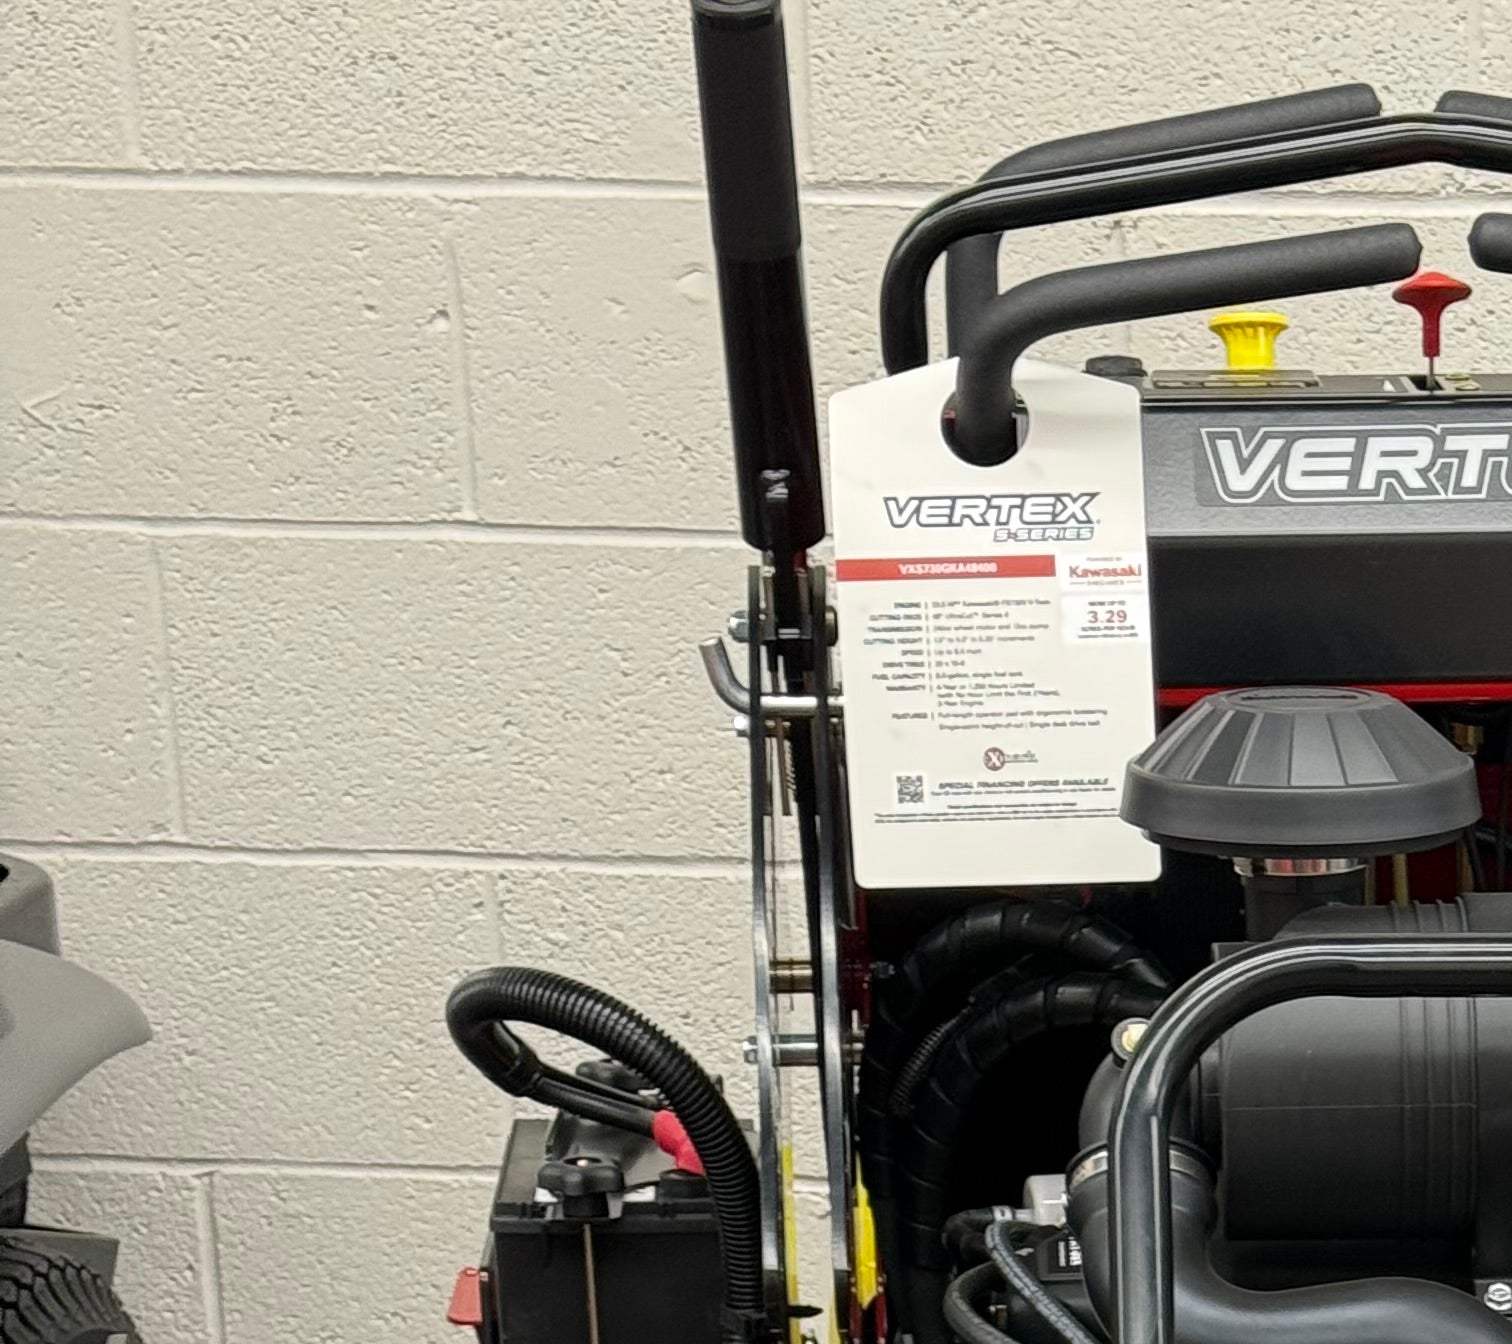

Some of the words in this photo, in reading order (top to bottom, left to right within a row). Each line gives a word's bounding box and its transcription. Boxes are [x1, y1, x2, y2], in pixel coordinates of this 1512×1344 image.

[884, 492, 1100, 528] VERTEX
[993, 527, 1094, 542] S-SERIES
[1068, 564, 1142, 578] Kawasaki
[1087, 609, 1128, 624] 3.29
